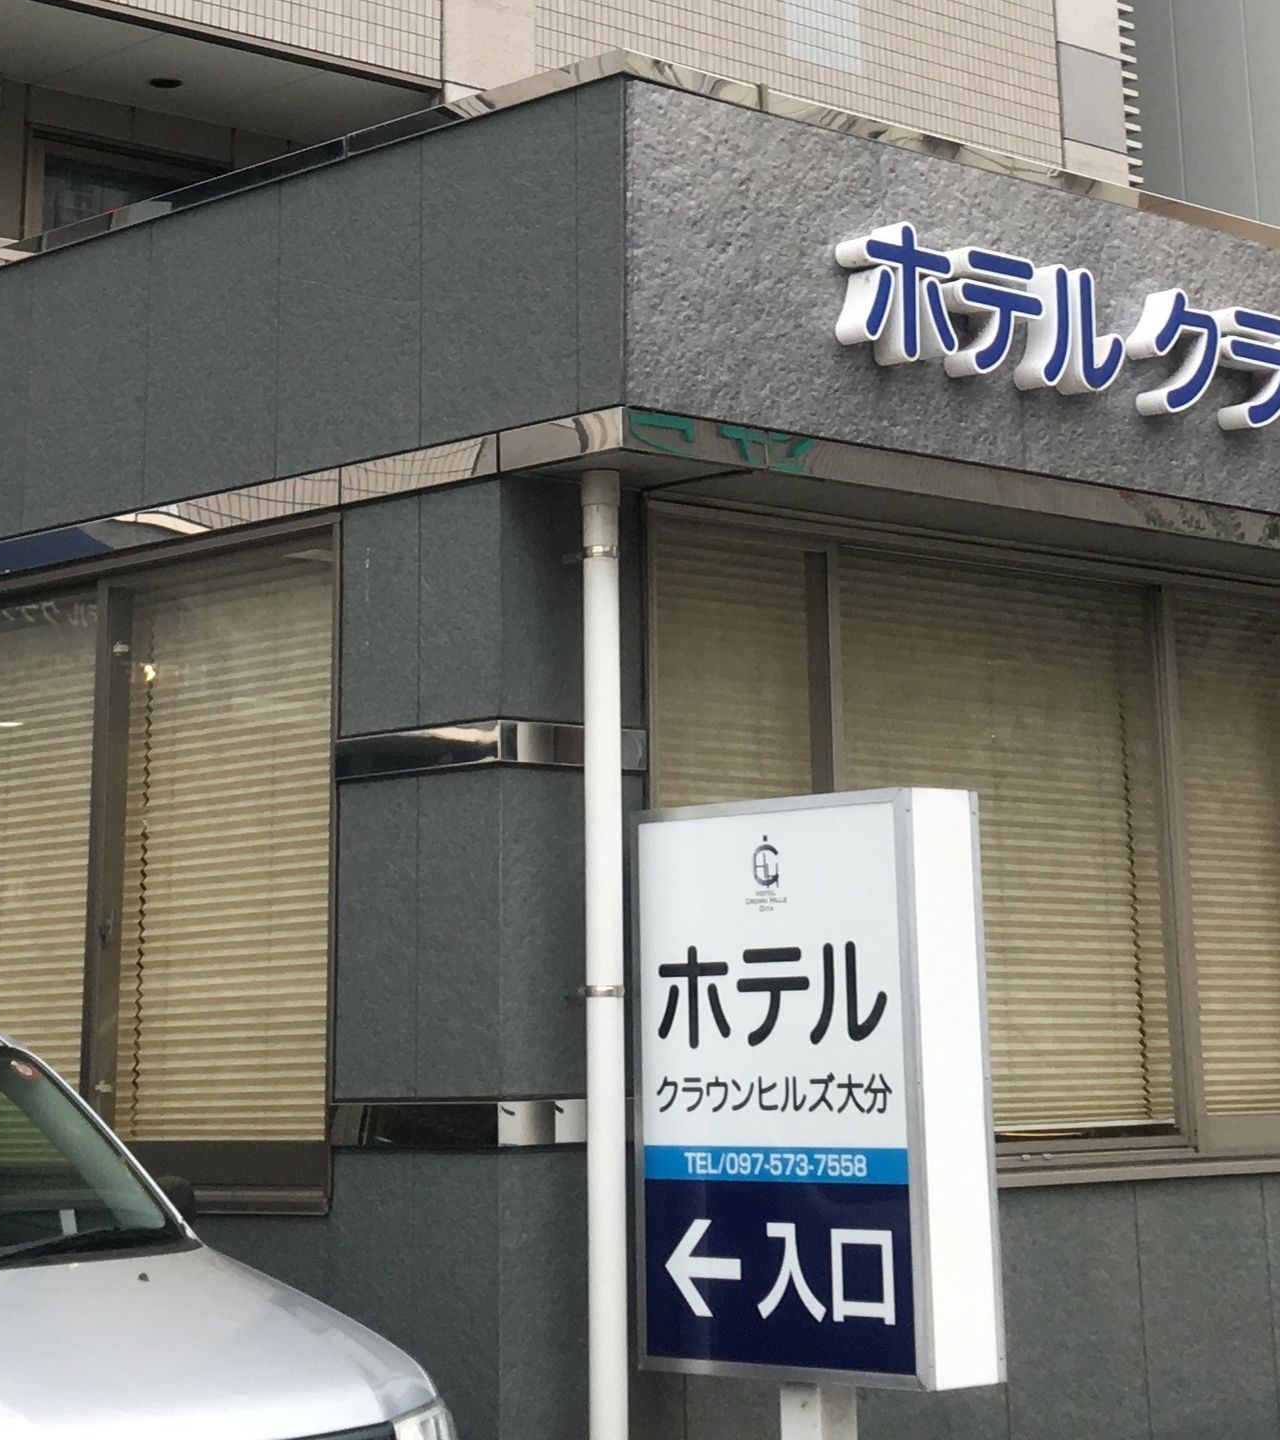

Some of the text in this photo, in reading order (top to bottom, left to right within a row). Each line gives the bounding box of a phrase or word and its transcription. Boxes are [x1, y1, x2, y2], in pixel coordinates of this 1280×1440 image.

[835, 220, 1124, 395] ホテル
[657, 939, 889, 1050] ホテル
[655, 1071, 893, 1115] クラウンヒルズ大分
[683, 1151, 868, 1178] TEL/097-573-7558
[757, 1221, 897, 1327] 入口
